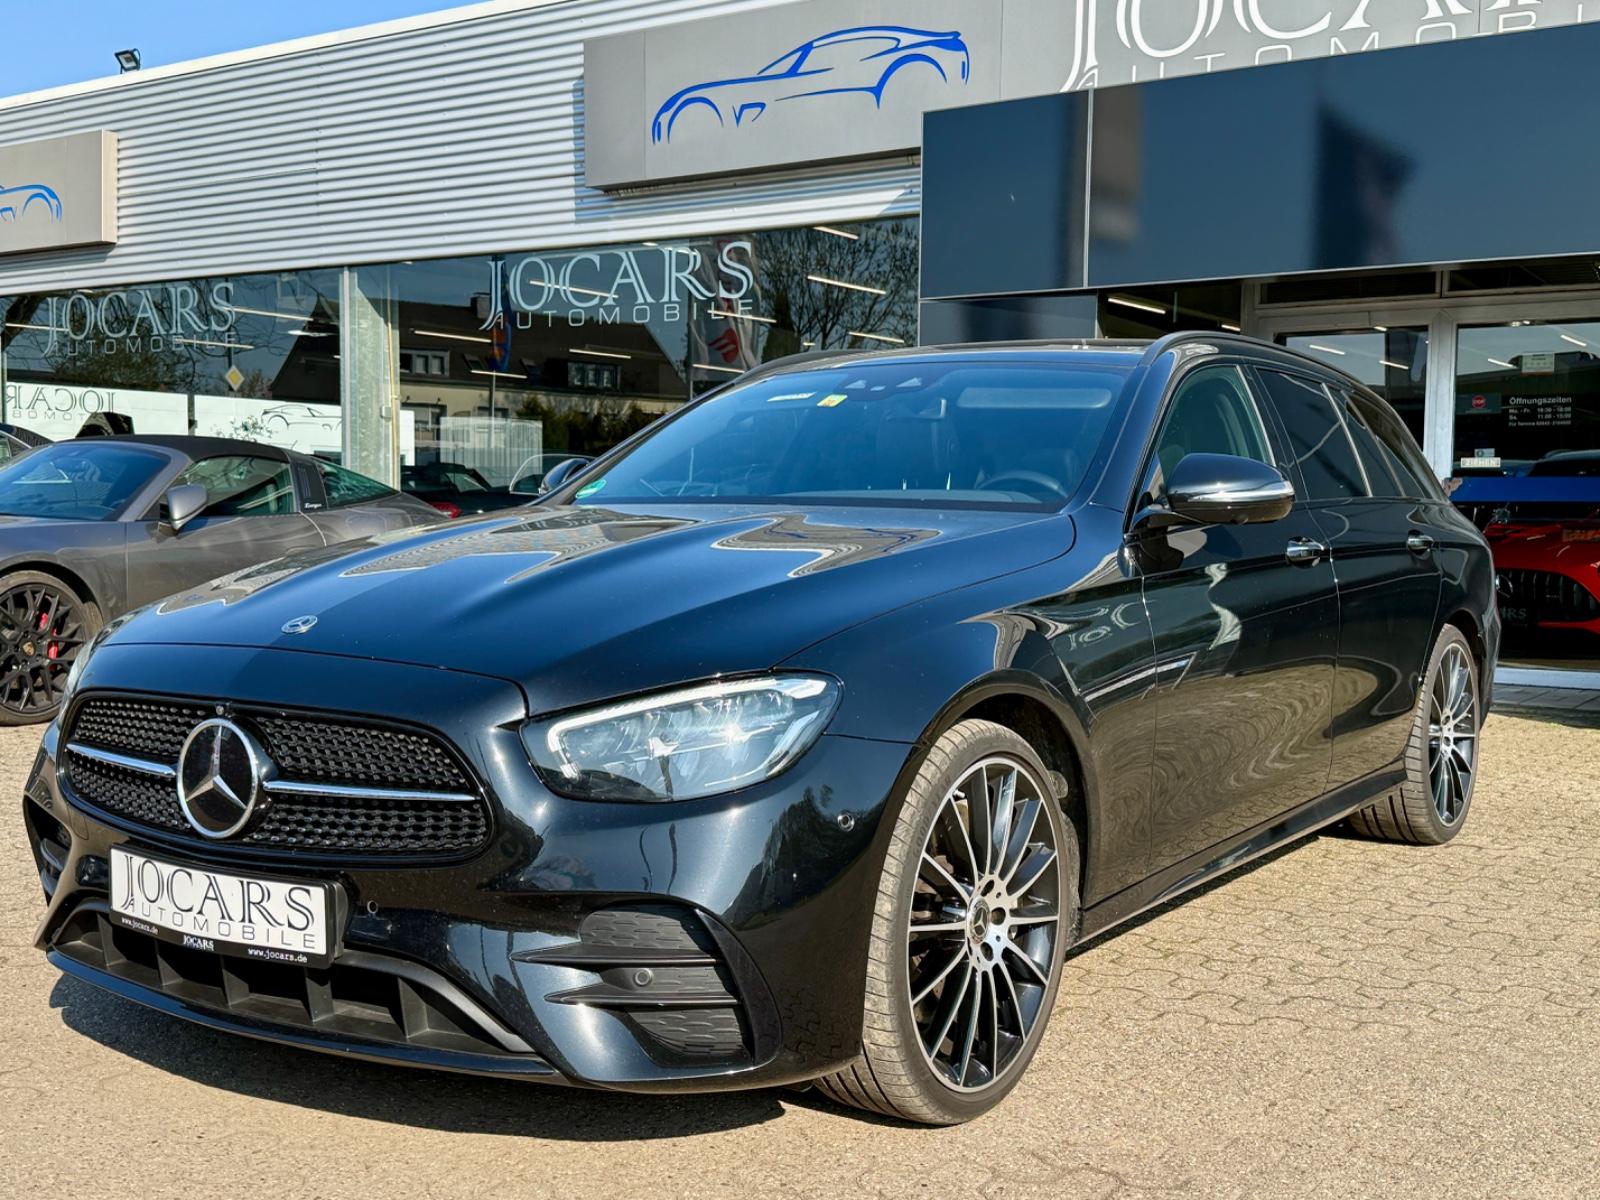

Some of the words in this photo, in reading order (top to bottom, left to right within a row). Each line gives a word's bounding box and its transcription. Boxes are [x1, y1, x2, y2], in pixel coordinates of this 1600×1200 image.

[479, 241, 754, 331] JOCARS
[41, 282, 236, 359] JOCARS
[491, 299, 753, 330] AUTOMOBILE
[121, 854, 315, 931] JOCARS
[125, 897, 316, 949] AUTOMOBILE
[183, 935, 214, 951] JOCARS
[248, 947, 308, 963] www.jocars.de
